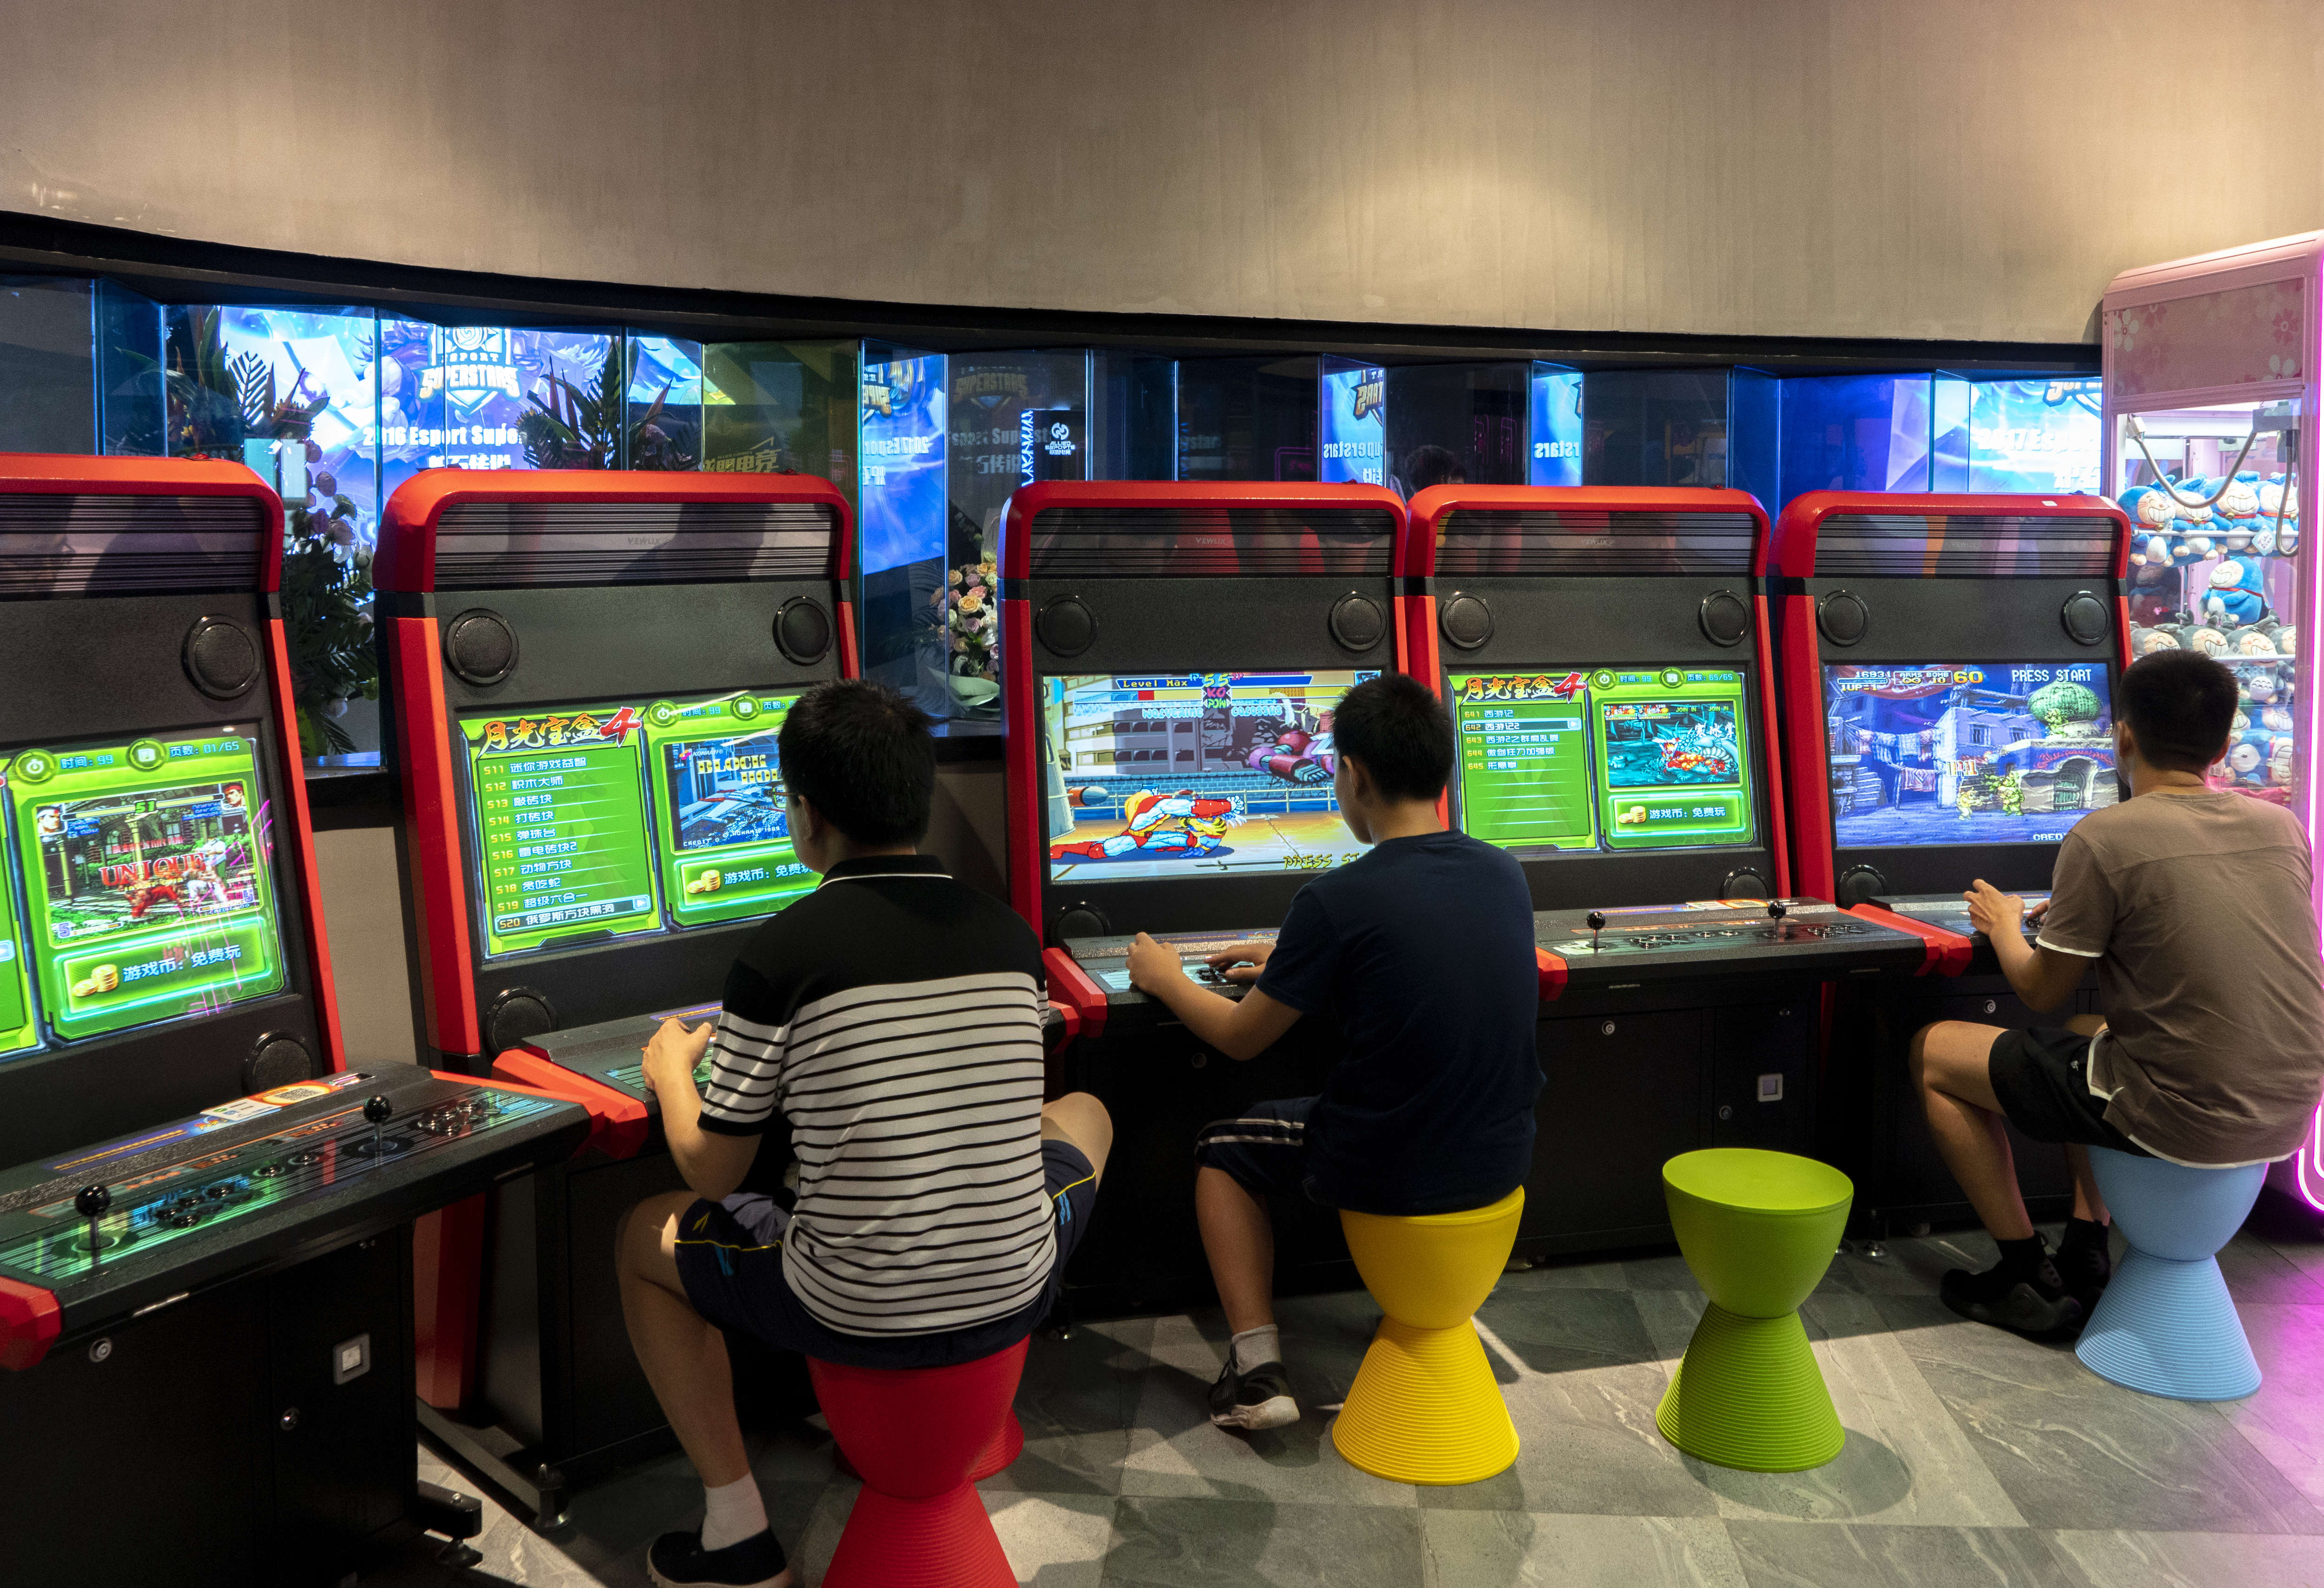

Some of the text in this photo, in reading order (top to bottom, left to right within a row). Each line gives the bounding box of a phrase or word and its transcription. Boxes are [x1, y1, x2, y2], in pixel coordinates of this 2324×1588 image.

[419, 364, 520, 398] SUPERSTARS
[409, 426, 467, 447] Esport
[1953, 670, 1984, 684] 60
[2012, 668, 2092, 682] PRESS START
[1123, 679, 1188, 688] Level Max
[1207, 687, 1227, 698] KO
[1142, 706, 1204, 719] WOLVERINE
[1231, 705, 1283, 717] COLOSSUS
[1484, 710, 1514, 718] 西游记
[1485, 722, 1520, 731] 西游记2
[484, 757, 587, 775] 511 迷你游戏益智
[697, 754, 767, 774] BLOCK
[486, 776, 563, 792] 512 积木大师
[740, 768, 783, 785] HOL
[135, 801, 156, 814] 51
[487, 794, 552, 809] 513 敲砖块
[489, 811, 554, 826] 514 打砖块
[491, 828, 556, 843] 515 弹珠台
[683, 838, 711, 847] CREDIT
[493, 842, 577, 860] 516 雷电砖块2
[495, 860, 572, 877] 517 动物方块
[1283, 852, 1368, 870] PRESS ST
[99, 852, 206, 887] UNIQUE
[496, 878, 561, 894] 518 贪吃蛇
[498, 893, 588, 911] 519 超级六合一
[500, 904, 614, 928] 520 俄罗斯方块黑洞
[58, 921, 71, 938] 5
